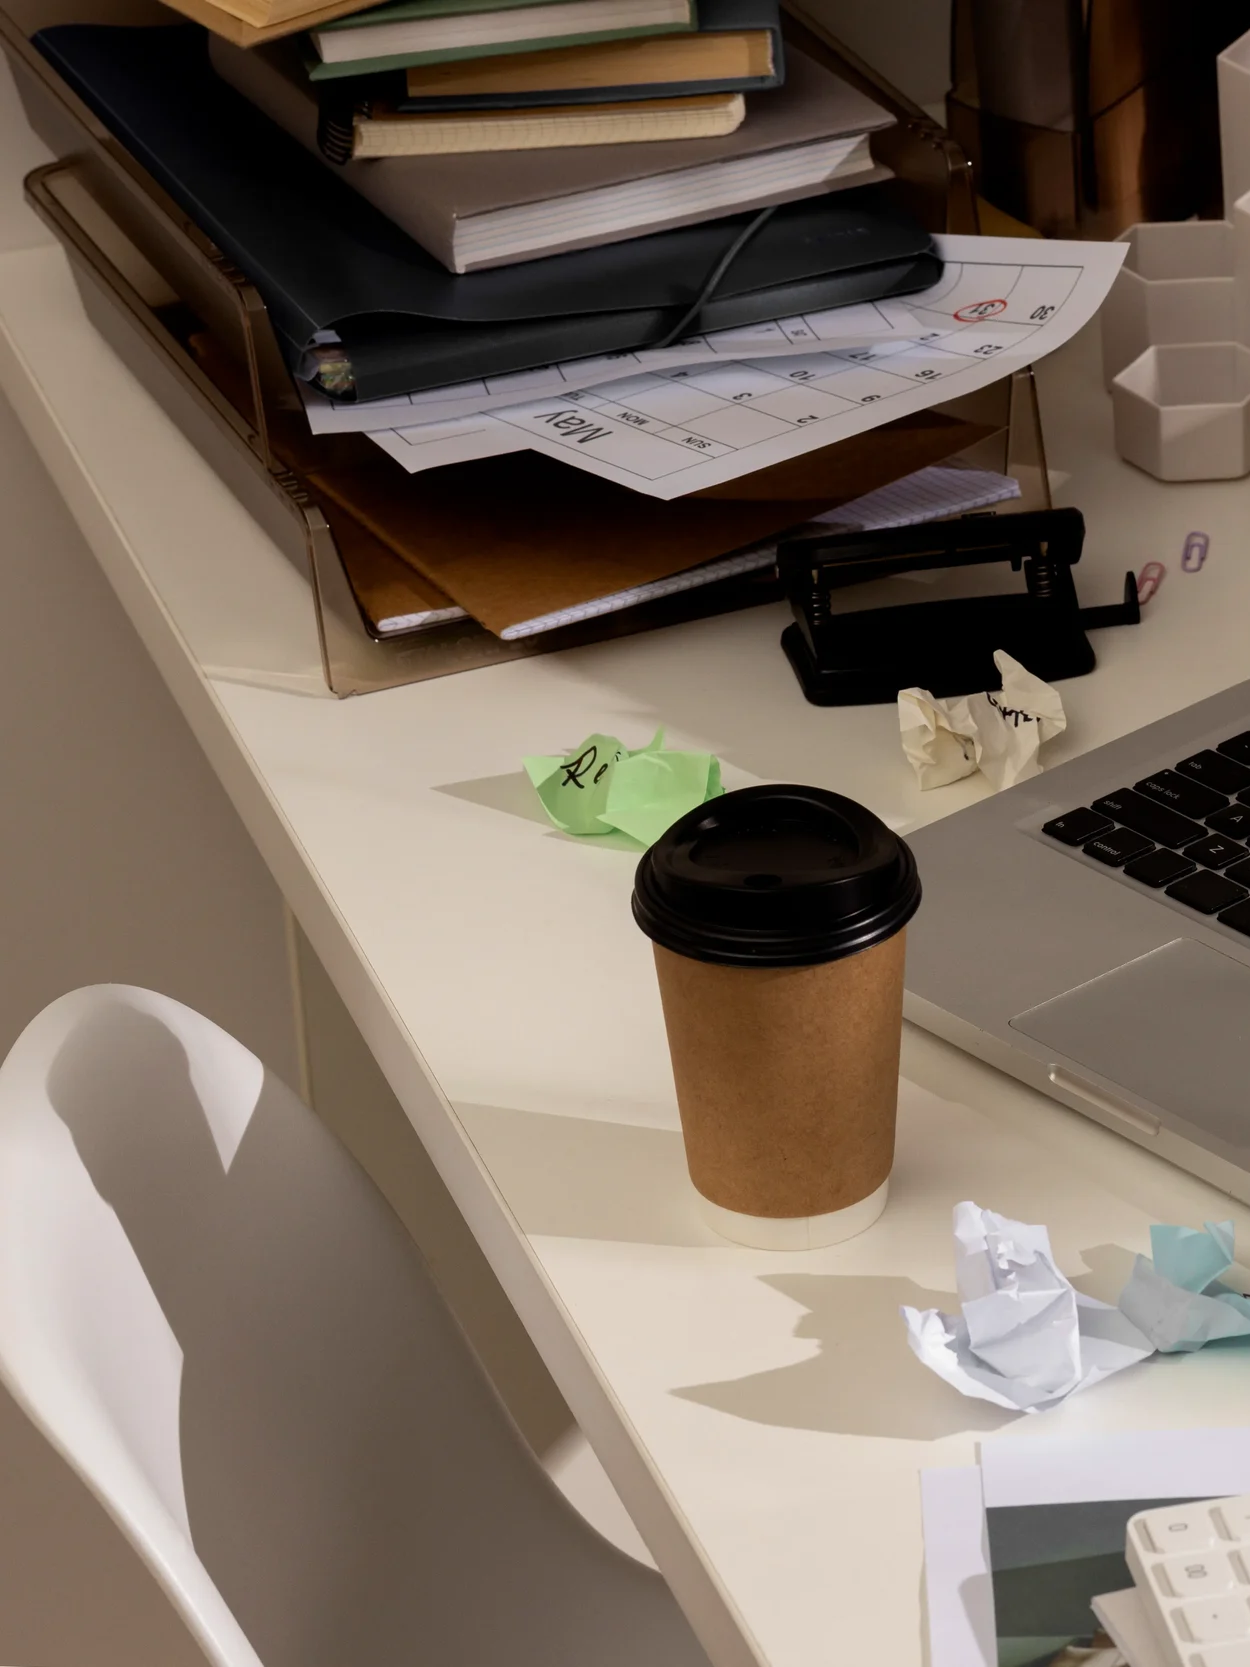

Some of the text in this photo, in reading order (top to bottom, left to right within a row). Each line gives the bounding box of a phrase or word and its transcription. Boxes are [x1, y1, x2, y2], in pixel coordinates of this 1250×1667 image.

[969, 303, 1055, 321] 31 30
[974, 344, 1003, 356] 23
[849, 351, 942, 381] 17 16
[789, 370, 881, 403] 10 9
[732, 392, 819, 425] 3 2
[534, 409, 612, 445] May
[617, 411, 649, 426] MON
[681, 436, 711, 449] SUN
[1188, 761, 1202, 770] tab
[1145, 781, 1180, 800] caps lock
[1103, 800, 1122, 810] shift
[1229, 815, 1244, 823] A
[1093, 841, 1121, 856] control
[1209, 845, 1225, 854] Z
[1168, 1522, 1188, 1532] 0
